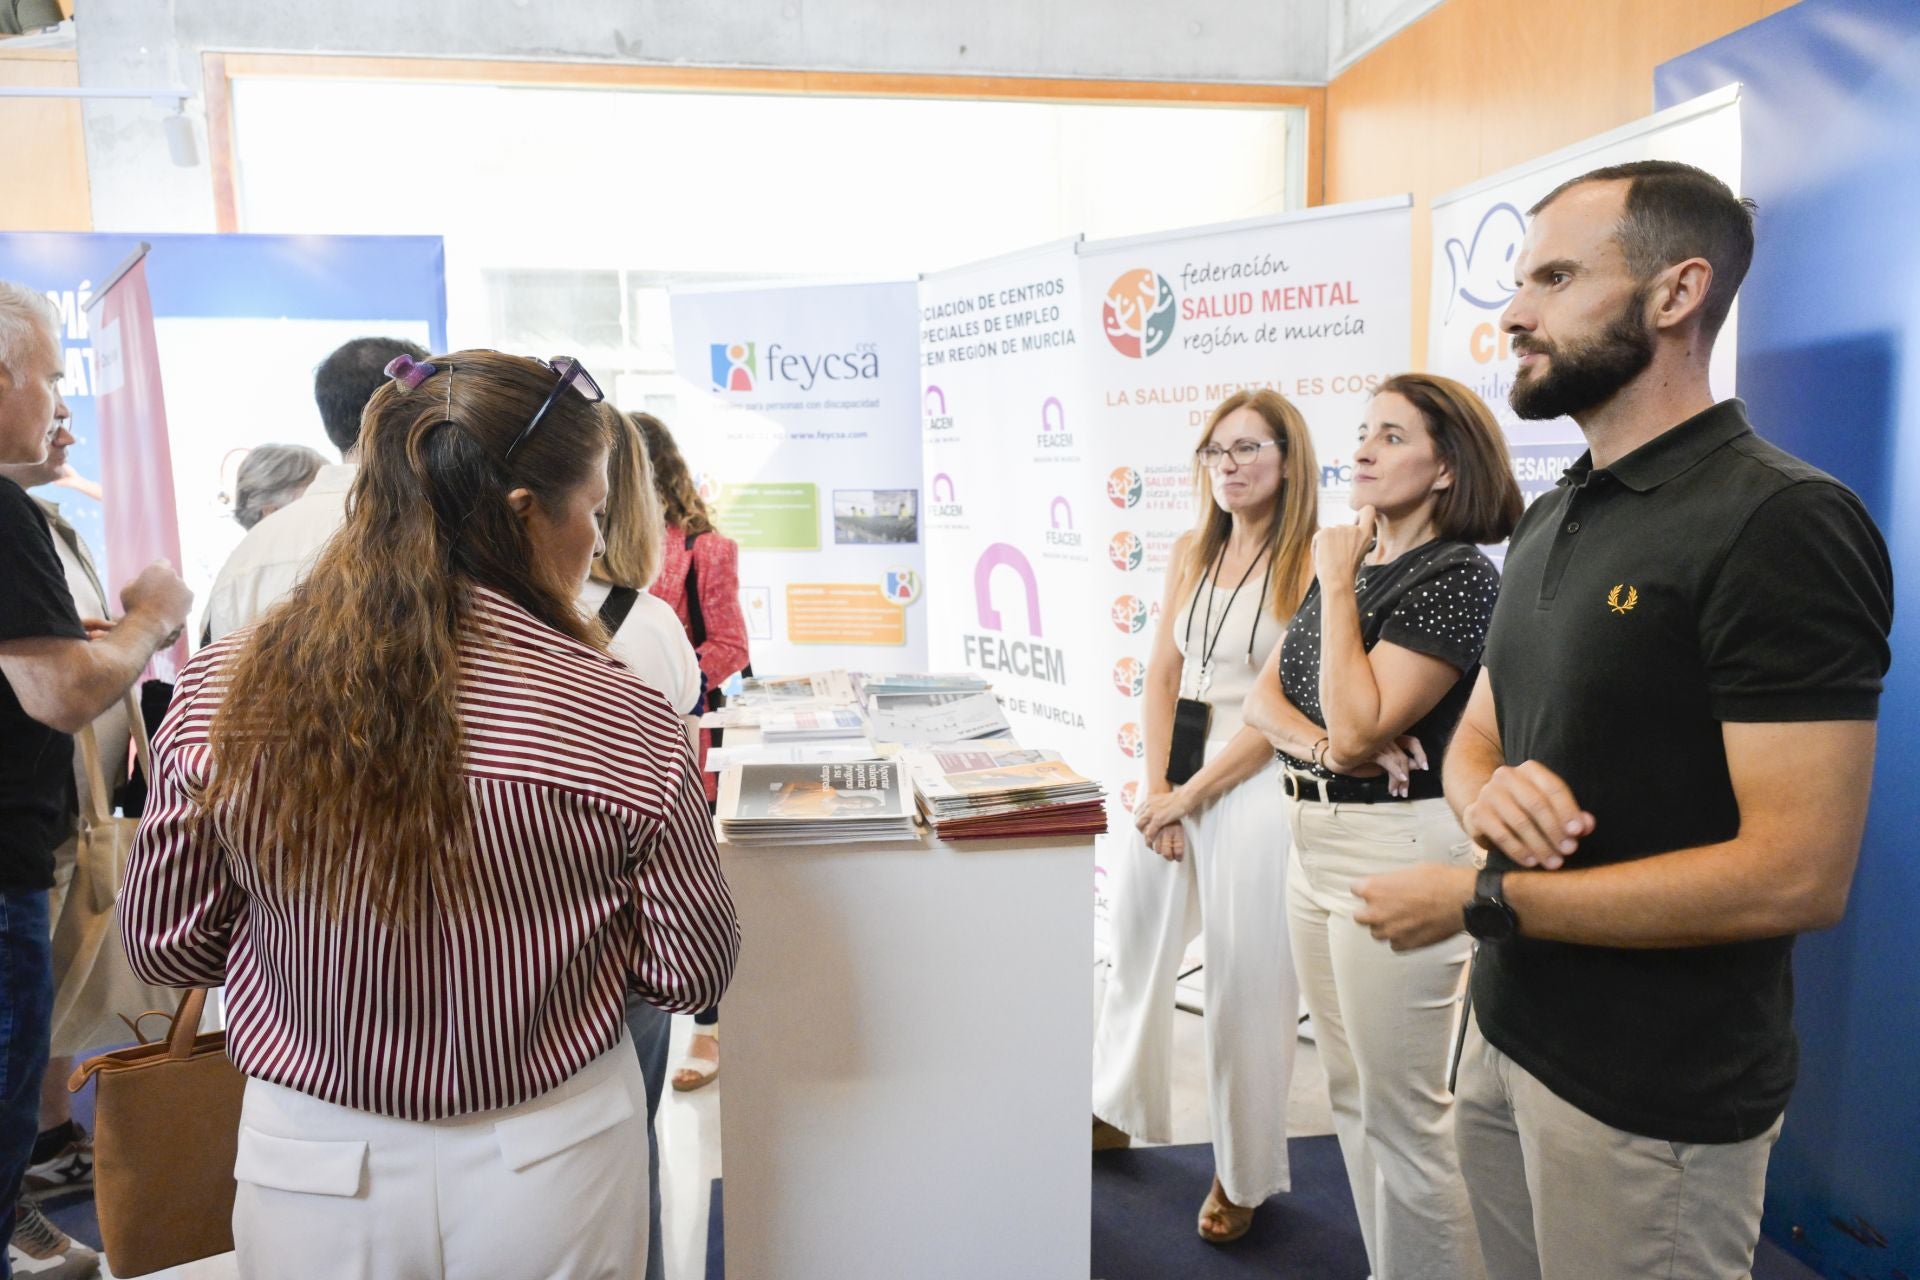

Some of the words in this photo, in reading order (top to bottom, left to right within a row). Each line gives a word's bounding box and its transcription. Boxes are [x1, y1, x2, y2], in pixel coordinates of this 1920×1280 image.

[1180, 254, 1289, 291] federación
[978, 293, 996, 311] DE
[1000, 278, 1065, 305] CENTROS
[1182, 291, 1253, 321] SALUD
[1262, 281, 1360, 313] MENTAL
[984, 316, 1002, 333] DE
[1006, 305, 1060, 330] EMPLEO
[1002, 337, 1018, 355] DE
[1022, 328, 1077, 352] MURCIA
[1183, 325, 1248, 355] región
[1254, 323, 1278, 343] de
[765, 343, 880, 391] feycsa
[824, 398, 880, 410] discapacidad
[1106, 390, 1130, 407] LA
[1135, 386, 1199, 406] SALUD
[1296, 378, 1324, 396] ES
[1036, 432, 1074, 449] FEACEM
[963, 634, 1067, 686] FEACEM
[1010, 697, 1028, 715] DE
[1033, 701, 1086, 729] MURCIA
[856, 764, 867, 789] aportar
[868, 764, 881, 787] valores
[879, 764, 891, 790] Aportar
